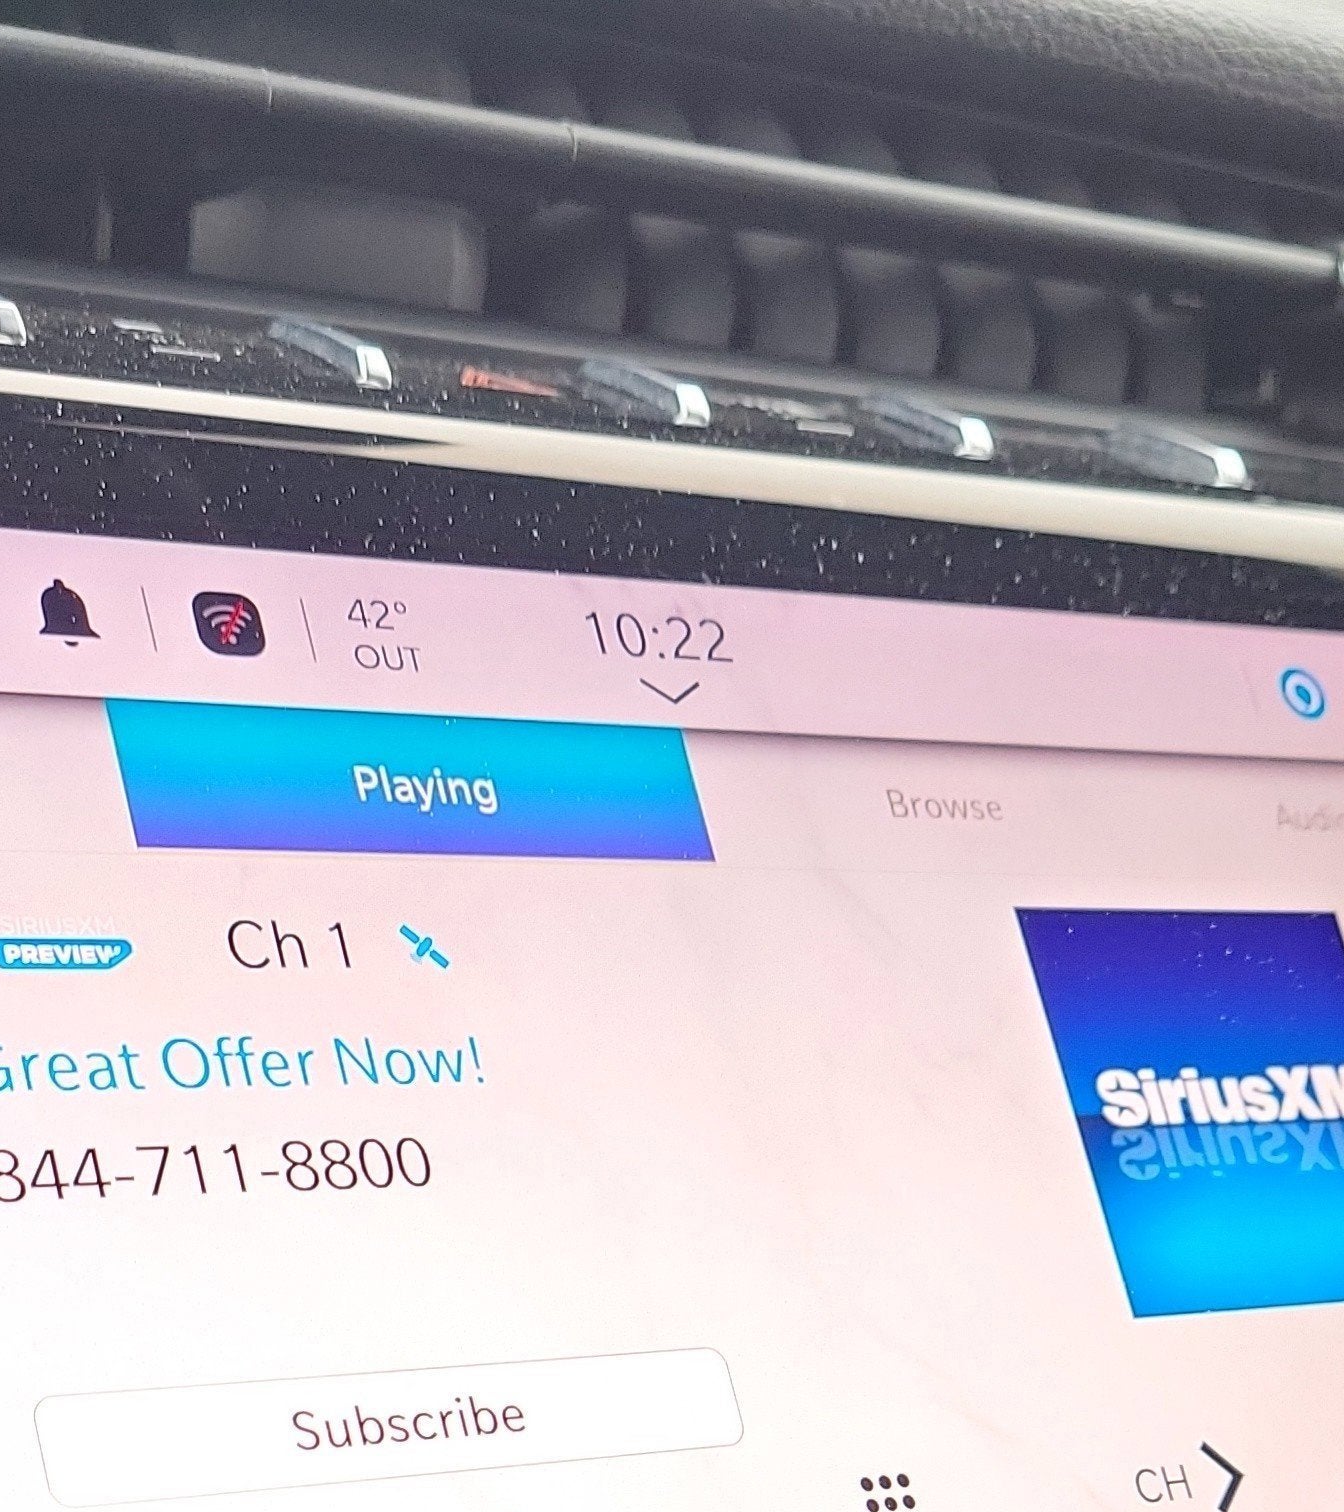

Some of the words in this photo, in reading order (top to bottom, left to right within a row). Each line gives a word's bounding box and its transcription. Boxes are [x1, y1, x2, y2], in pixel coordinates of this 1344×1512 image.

[354, 643, 422, 674] OUT
[584, 611, 736, 665] 10:22
[353, 764, 500, 816] Playing
[886, 788, 1004, 823] Browse
[2, 943, 123, 966] PREVIEW
[227, 919, 309, 970] Ch
[328, 920, 353, 970] 1
[161, 1035, 317, 1090] Offer
[332, 1035, 487, 1087] Now!
[291, 1396, 527, 1451] Subscribe
[1135, 1464, 1194, 1503] CH
